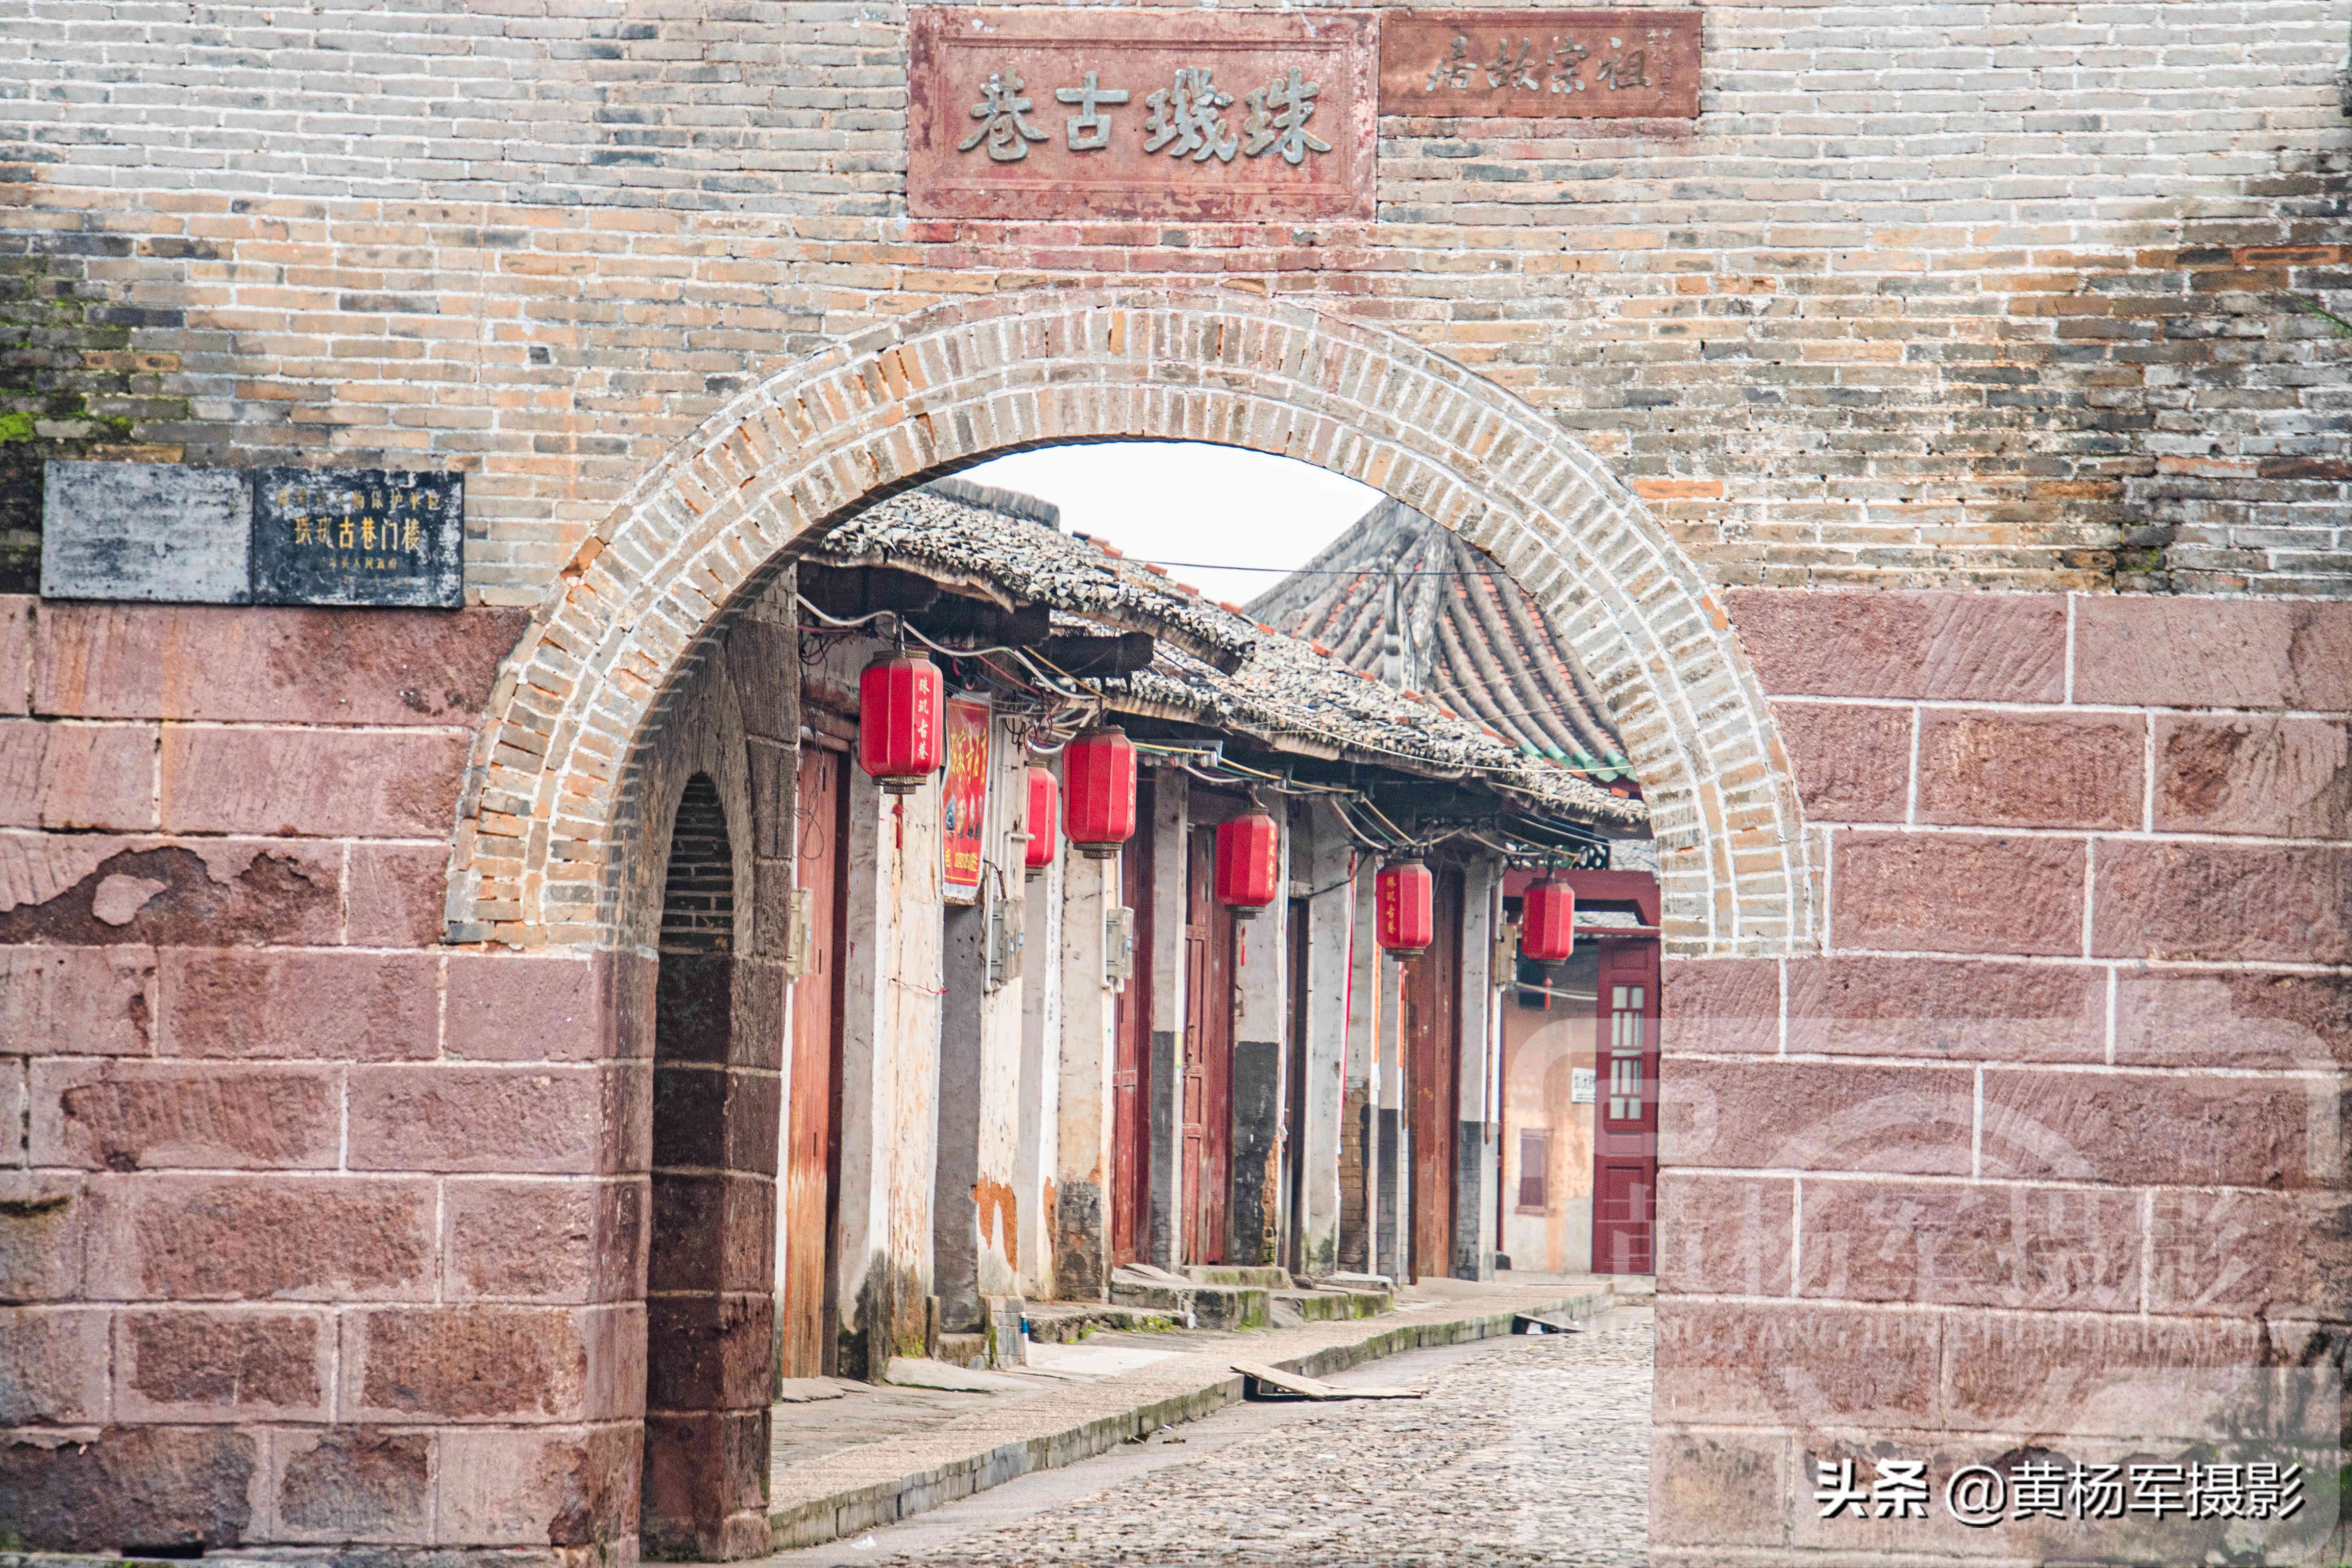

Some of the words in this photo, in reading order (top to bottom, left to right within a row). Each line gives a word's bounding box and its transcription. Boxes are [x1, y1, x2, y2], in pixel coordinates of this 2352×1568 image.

[1425, 36, 1651, 94] 祖宗故居
[277, 486, 441, 511] 物保护单位
[294, 515, 420, 554] 珠玑古巷门楼
[917, 676, 931, 760] 珠玑古巷
